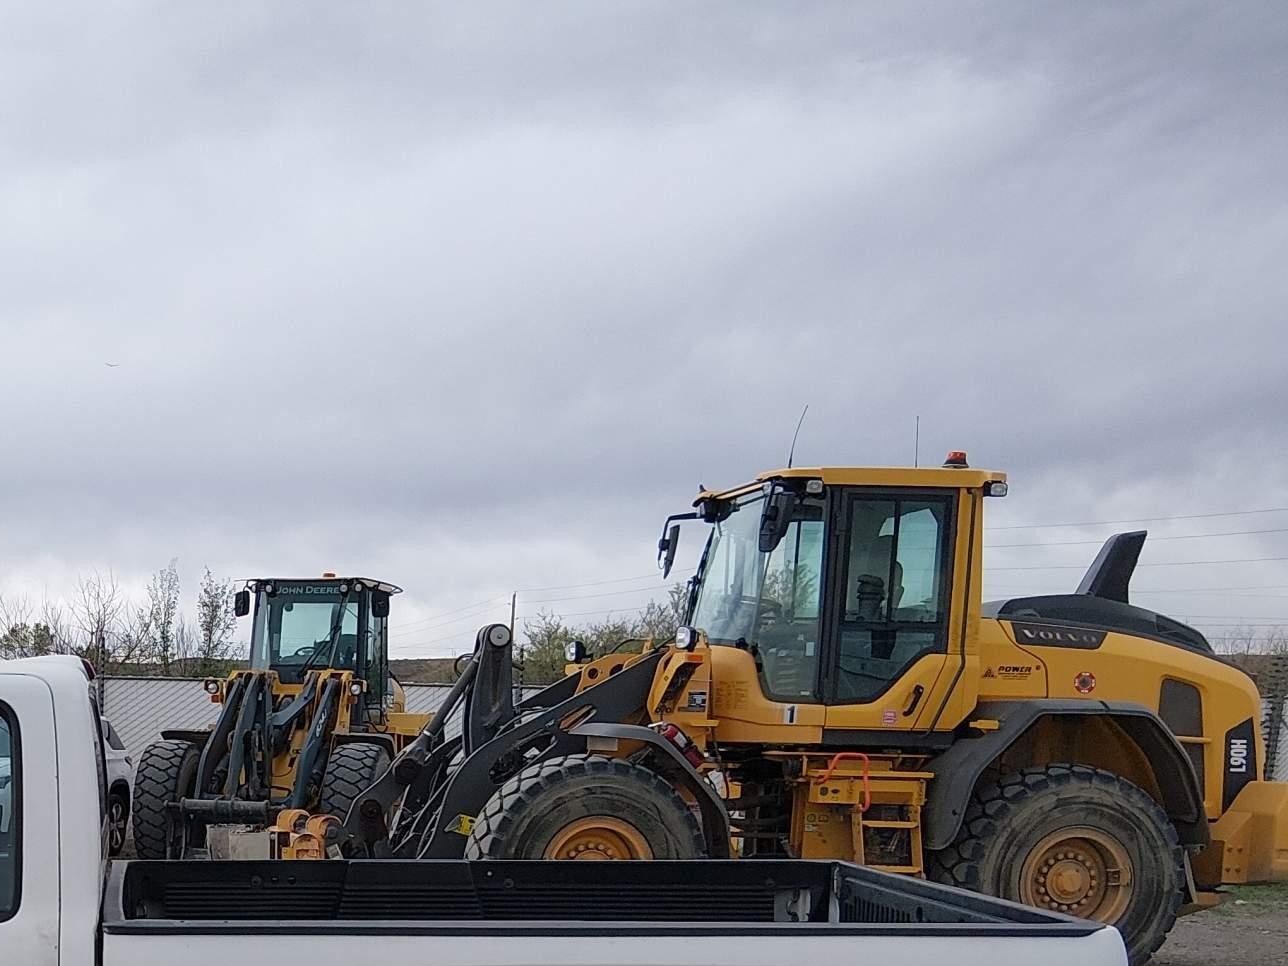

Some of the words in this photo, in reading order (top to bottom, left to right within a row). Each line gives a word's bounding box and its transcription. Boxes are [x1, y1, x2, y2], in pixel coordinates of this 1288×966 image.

[276, 585, 303, 594] JOHN
[305, 585, 340, 594] DEERE
[1022, 629, 1096, 642] VOLVO
[998, 665, 1032, 673] POWER
[1229, 738, 1248, 773] L90H
